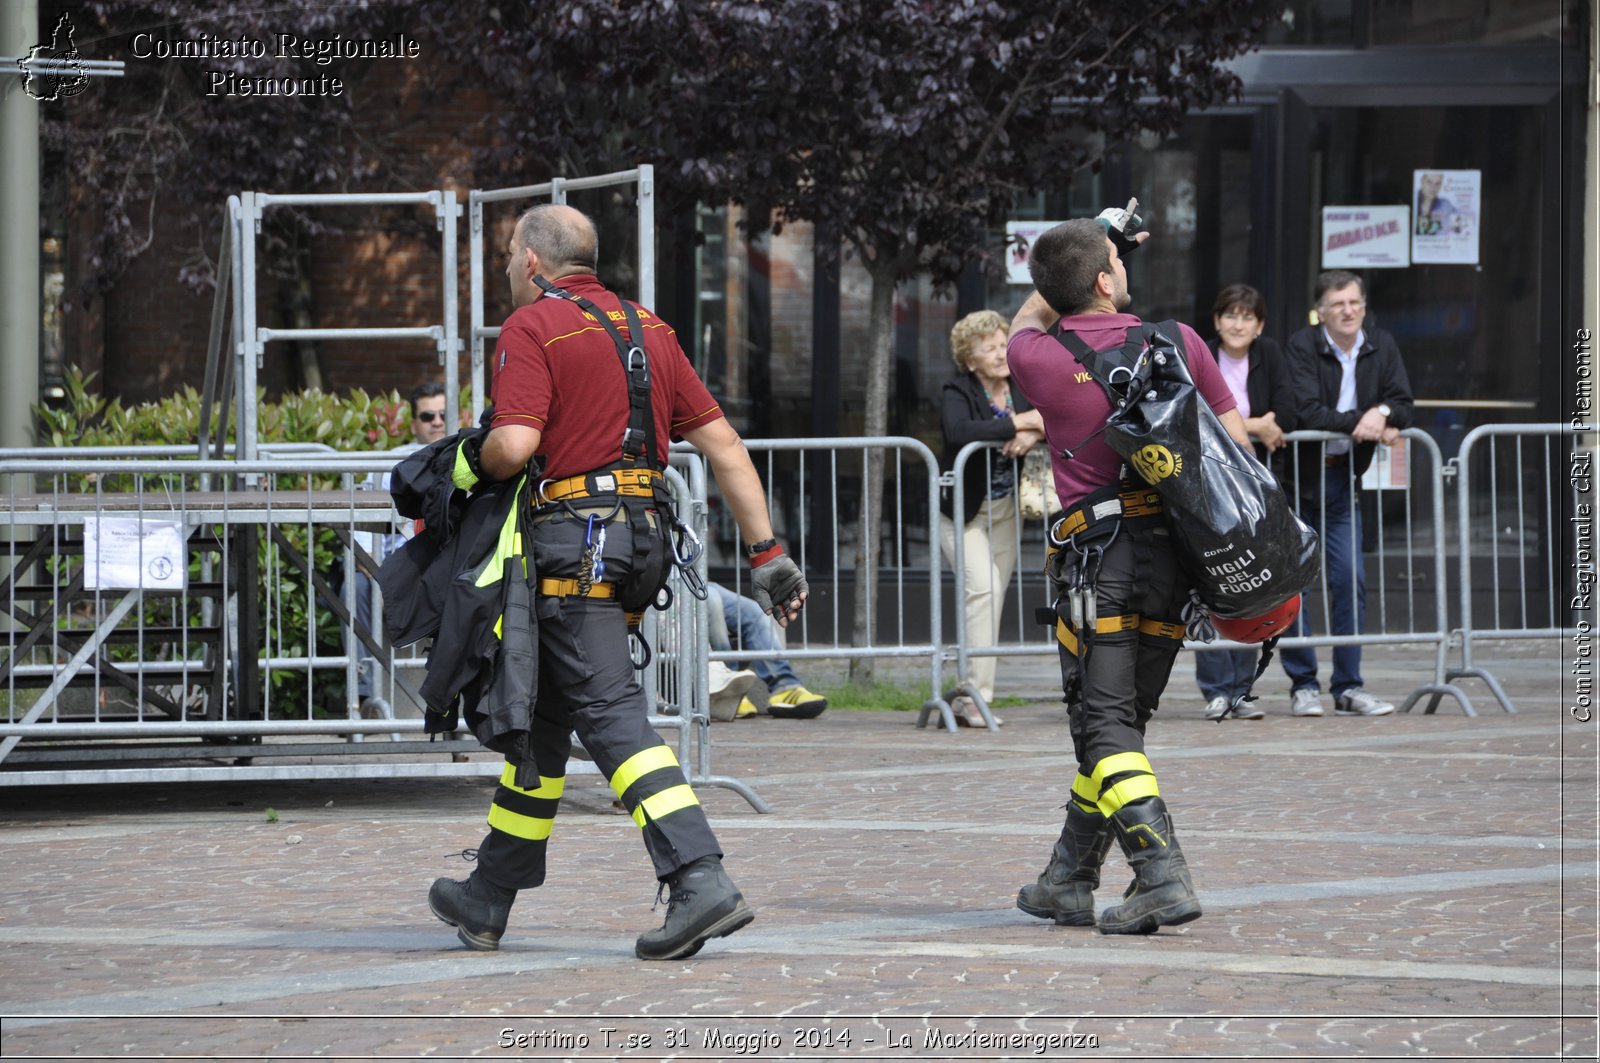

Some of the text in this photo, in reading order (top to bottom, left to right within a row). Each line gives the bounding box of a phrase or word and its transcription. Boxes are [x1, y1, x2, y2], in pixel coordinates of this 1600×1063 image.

[1173, 453, 1183, 477] ITALY
[1204, 543, 1235, 557] CORDE
[1205, 549, 1256, 576] VIGILI
[1219, 568, 1272, 594] FUOCO
[1226, 570, 1253, 584] DEL
